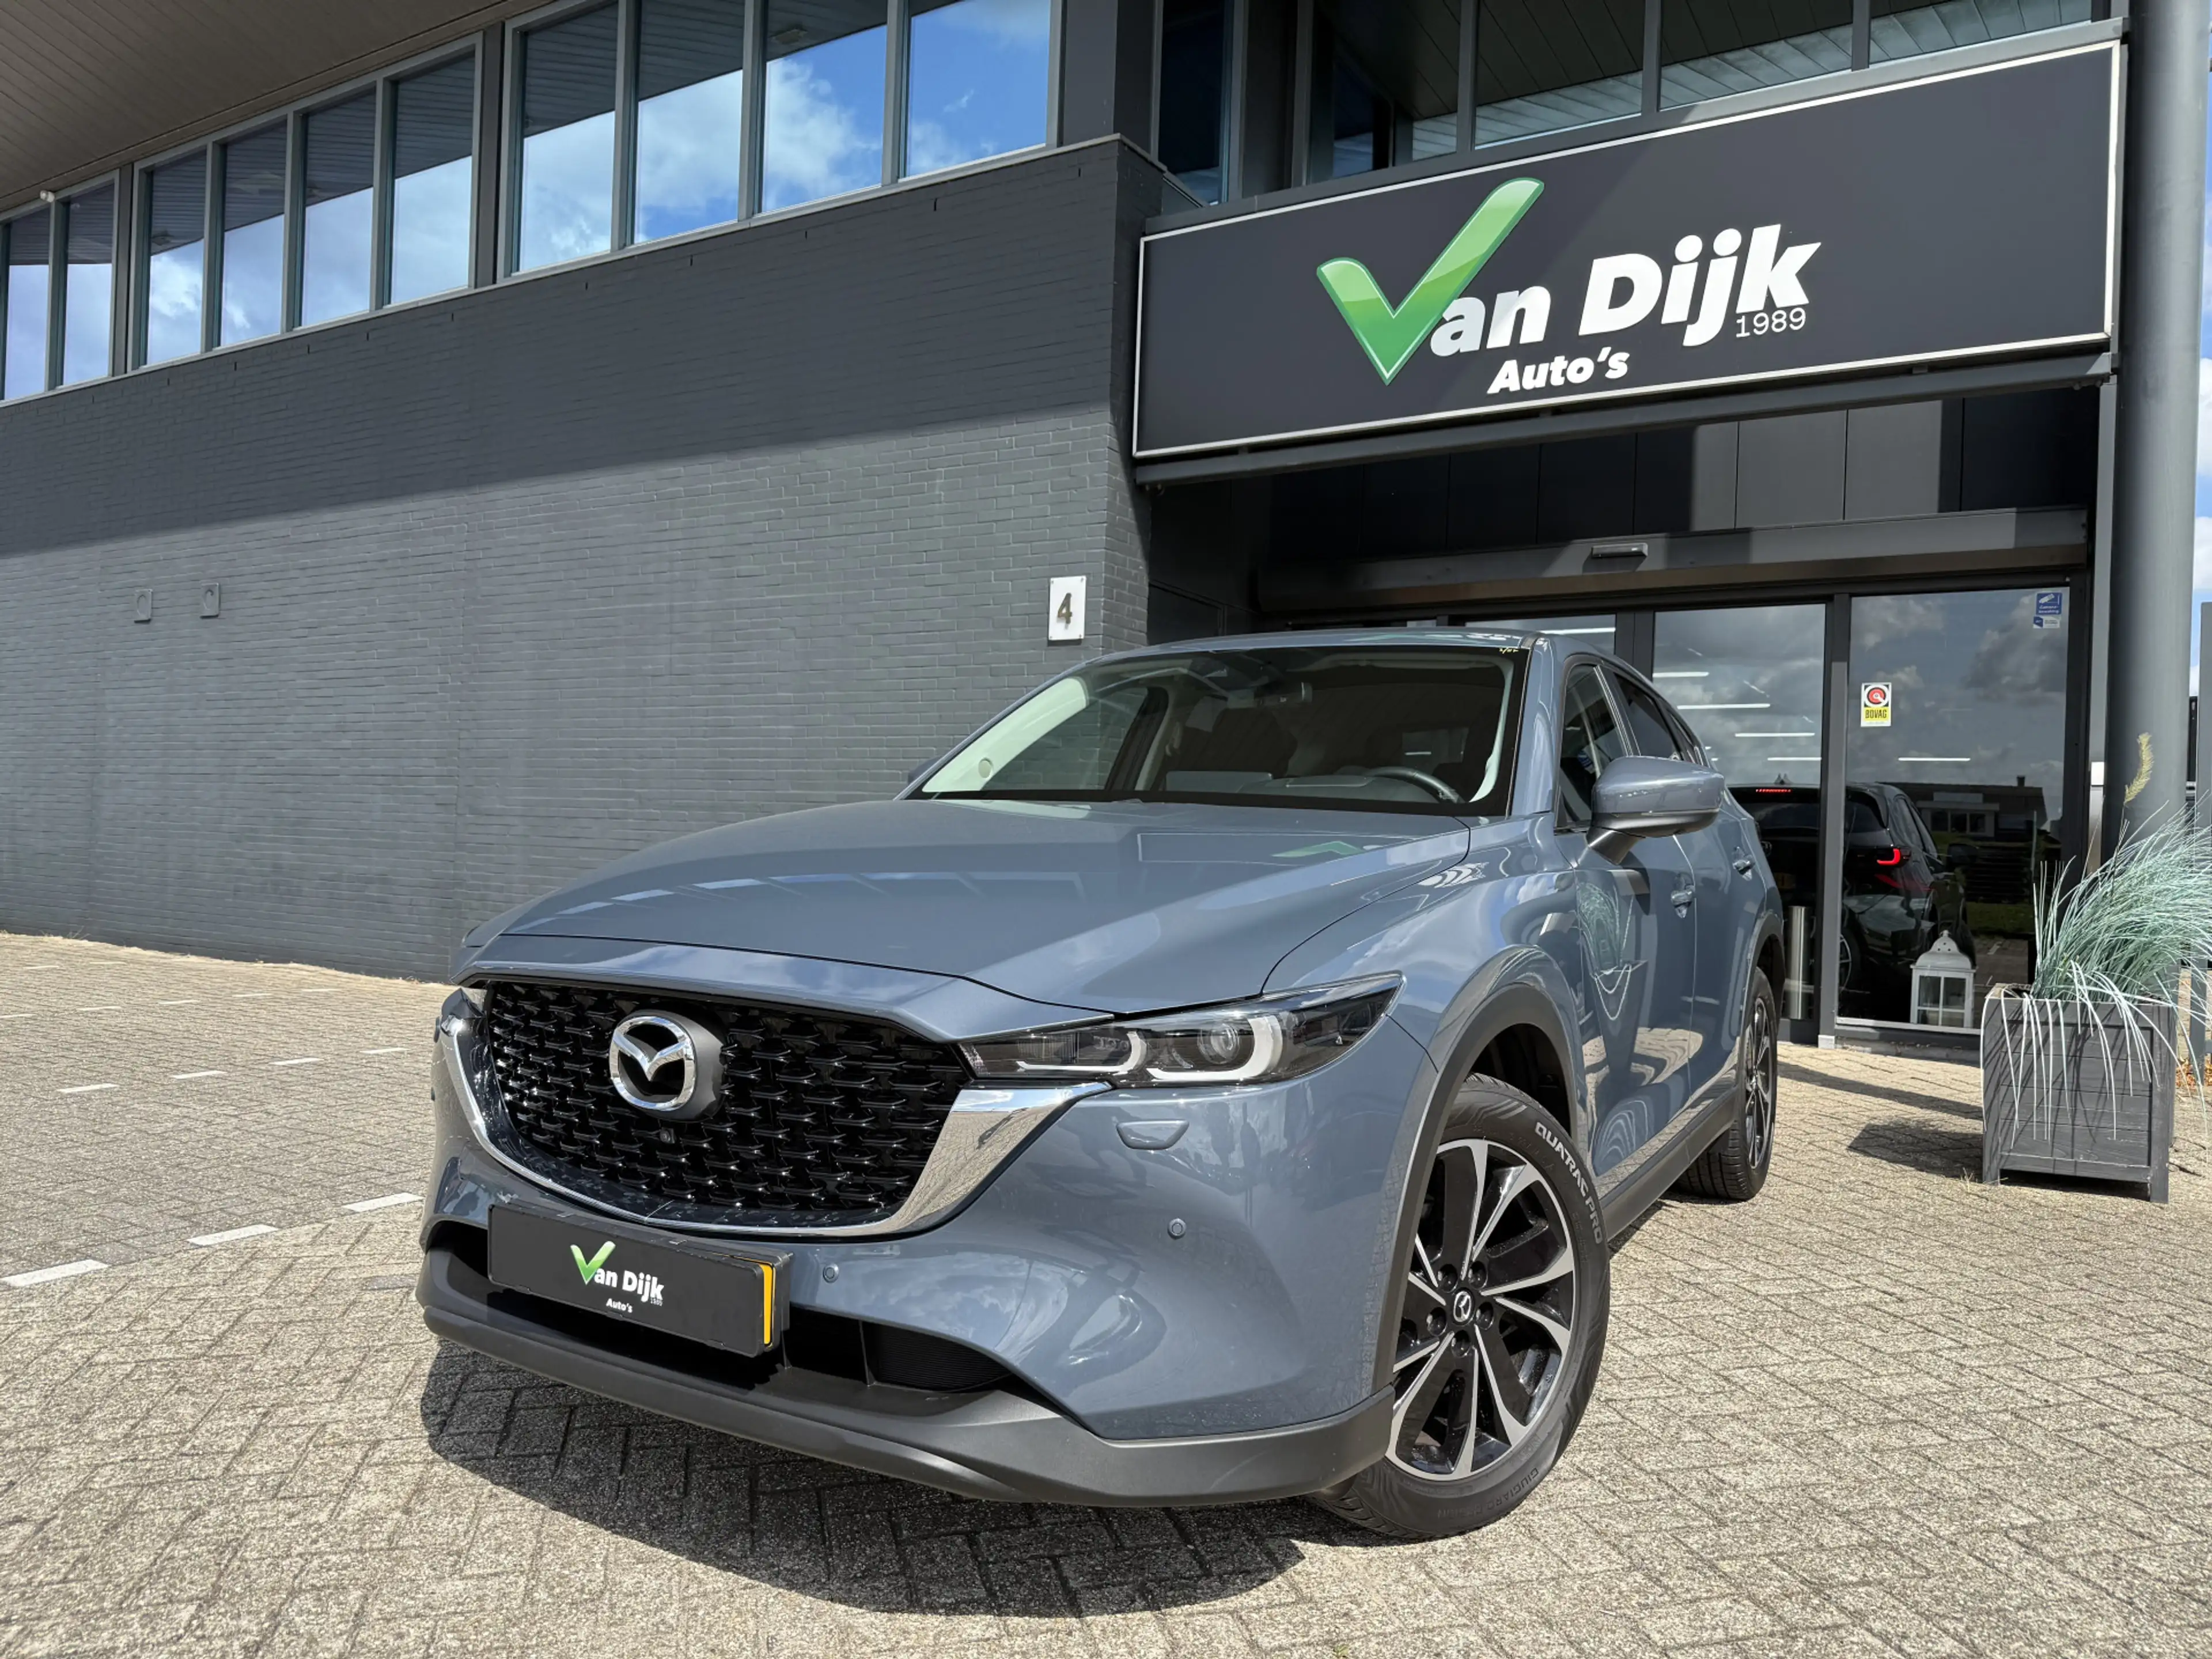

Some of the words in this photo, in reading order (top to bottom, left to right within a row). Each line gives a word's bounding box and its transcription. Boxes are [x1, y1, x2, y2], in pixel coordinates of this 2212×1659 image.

[1578, 224, 1821, 347] Dijk
[1736, 309, 1806, 338] 1989
[1487, 346, 1630, 395] Auto's
[1058, 592, 1073, 624] 4
[1865, 709, 1887, 719] BOVAG
[1535, 1122, 1588, 1197] QUATRAC
[1585, 1196, 1603, 1244] PRO
[622, 1270, 664, 1302] Dijk
[606, 1298, 633, 1313] Auto's
